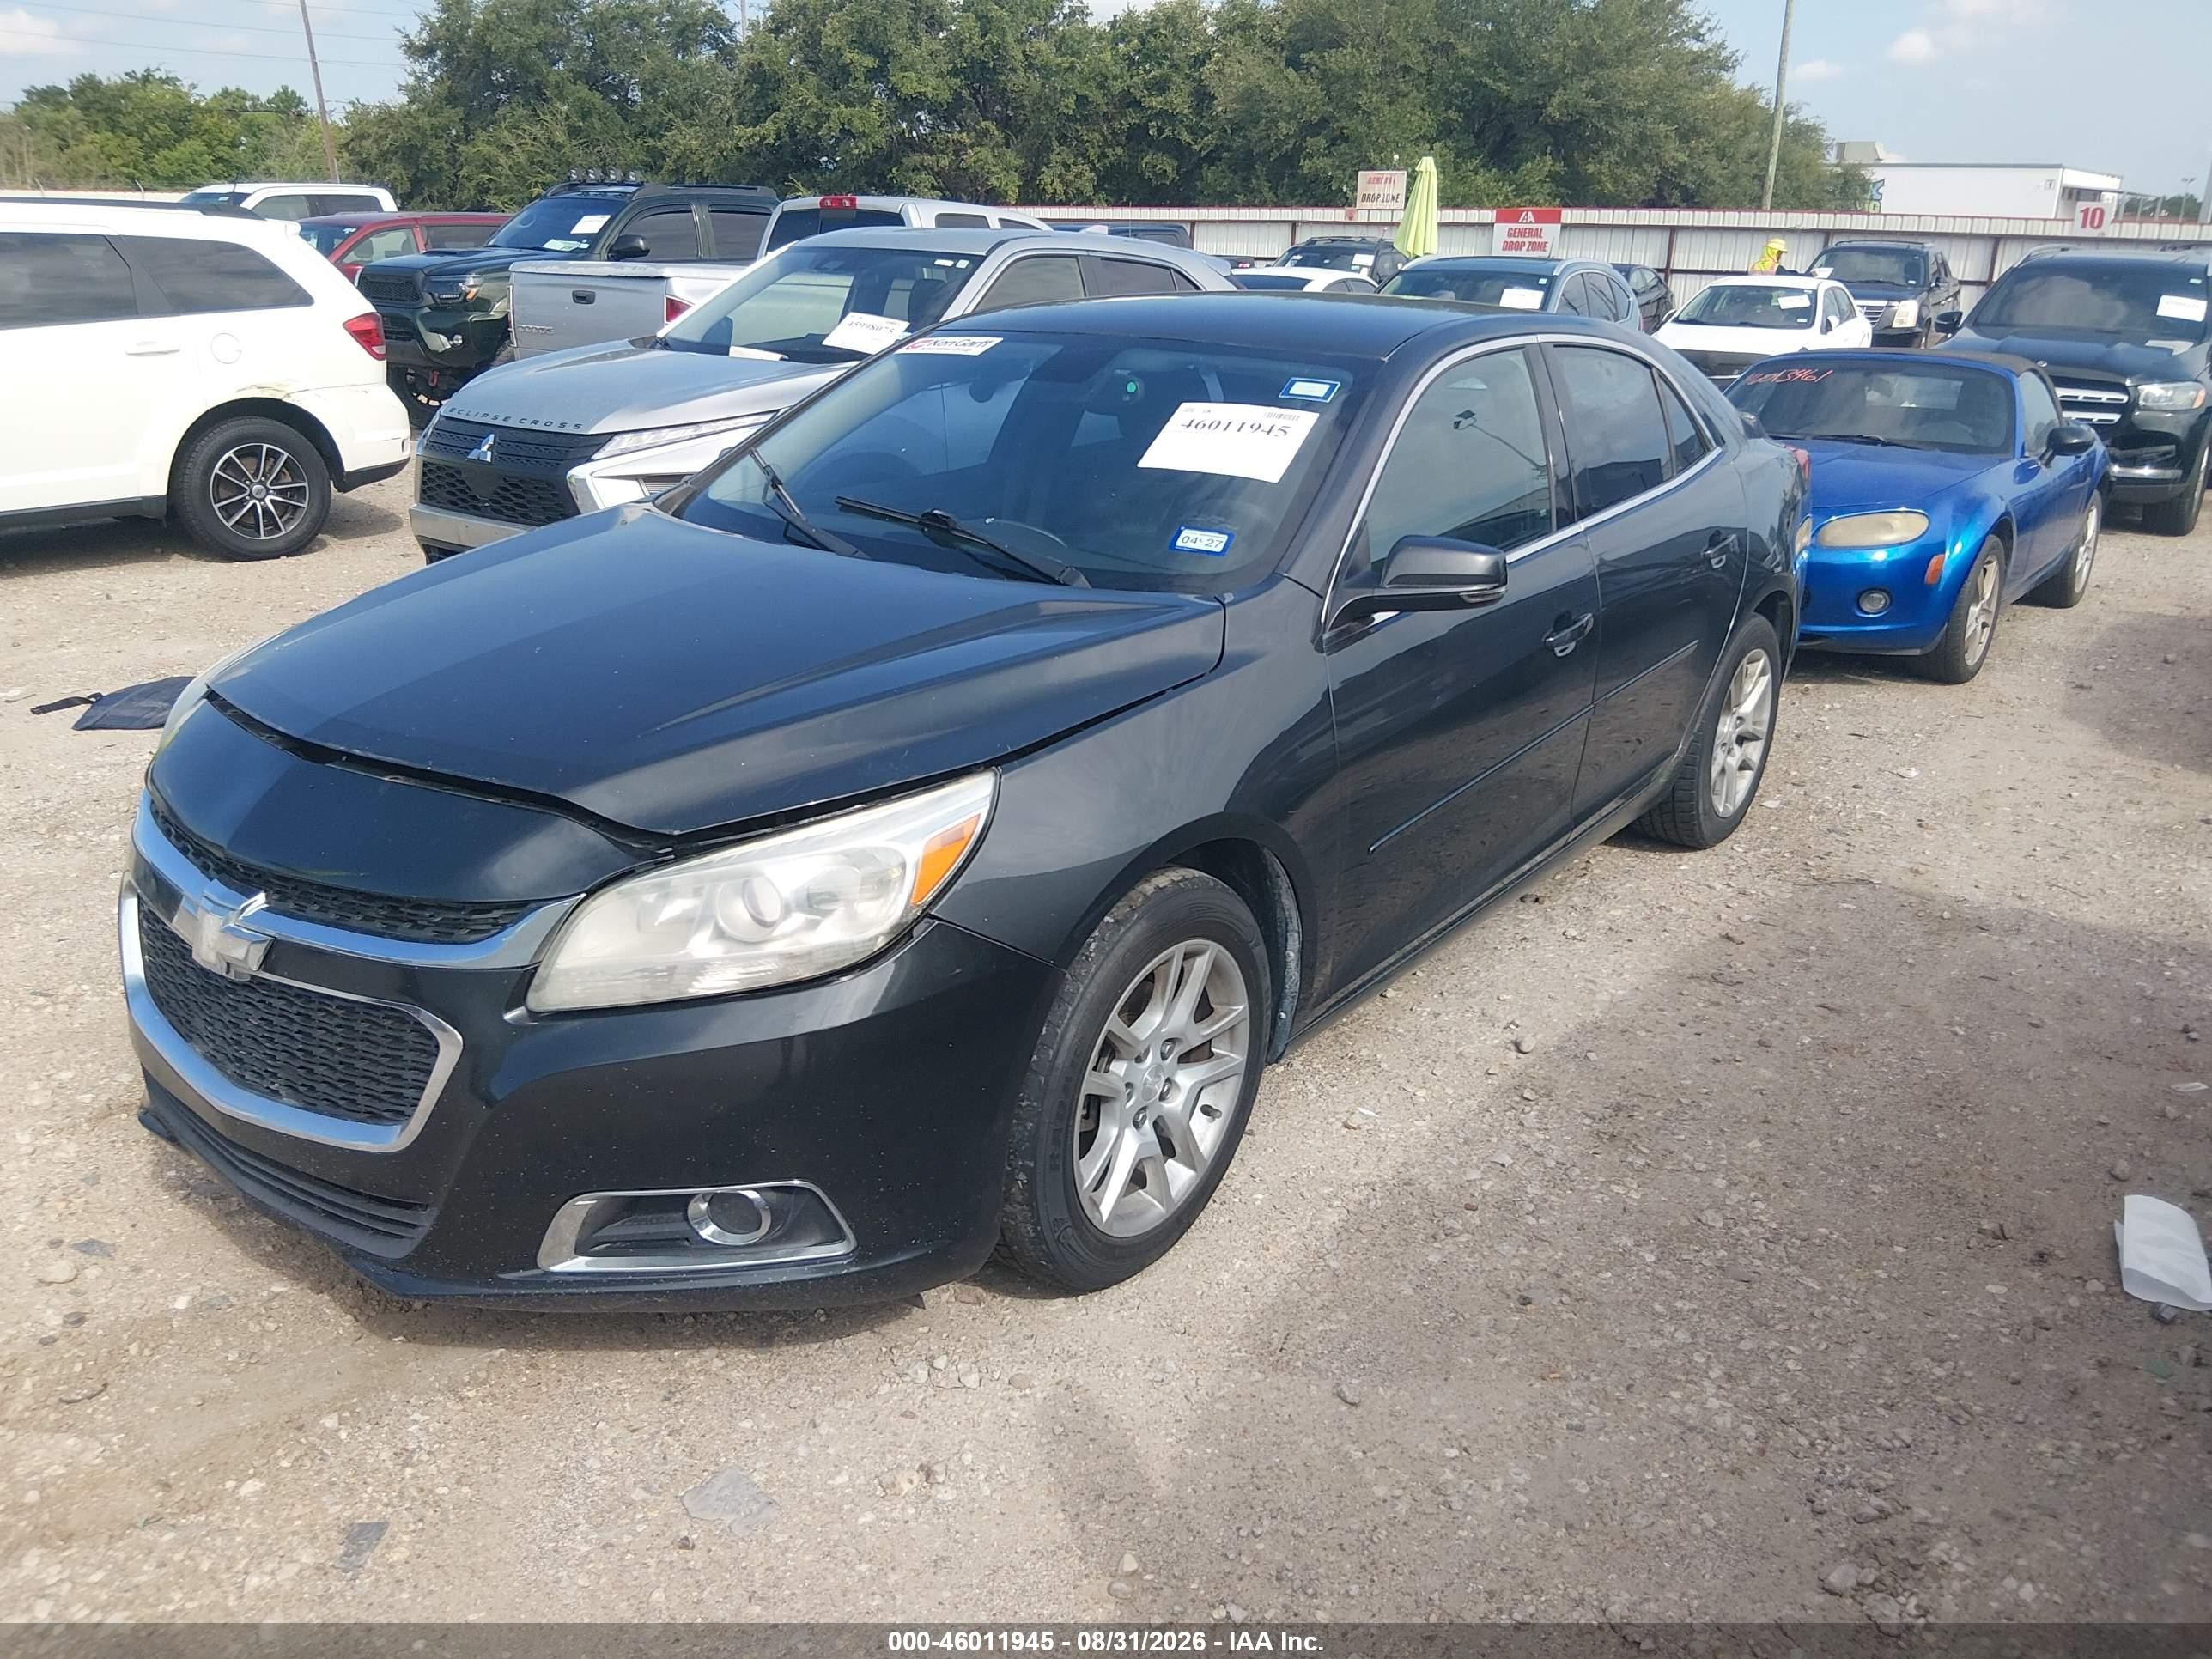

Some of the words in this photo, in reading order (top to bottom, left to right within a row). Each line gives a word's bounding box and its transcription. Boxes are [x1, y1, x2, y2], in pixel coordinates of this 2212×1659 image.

[2080, 207, 2105, 229] 10
[1507, 228, 1543, 238] GENERAL
[1502, 240, 1526, 252] DROP
[1526, 241, 1549, 252] ZONE
[449, 407, 511, 422] ECLIPSE
[519, 417, 583, 430] CROSS
[1181, 418, 1291, 438] 46011945
[1182, 535, 1199, 545] 04
[1205, 538, 1223, 548] 27
